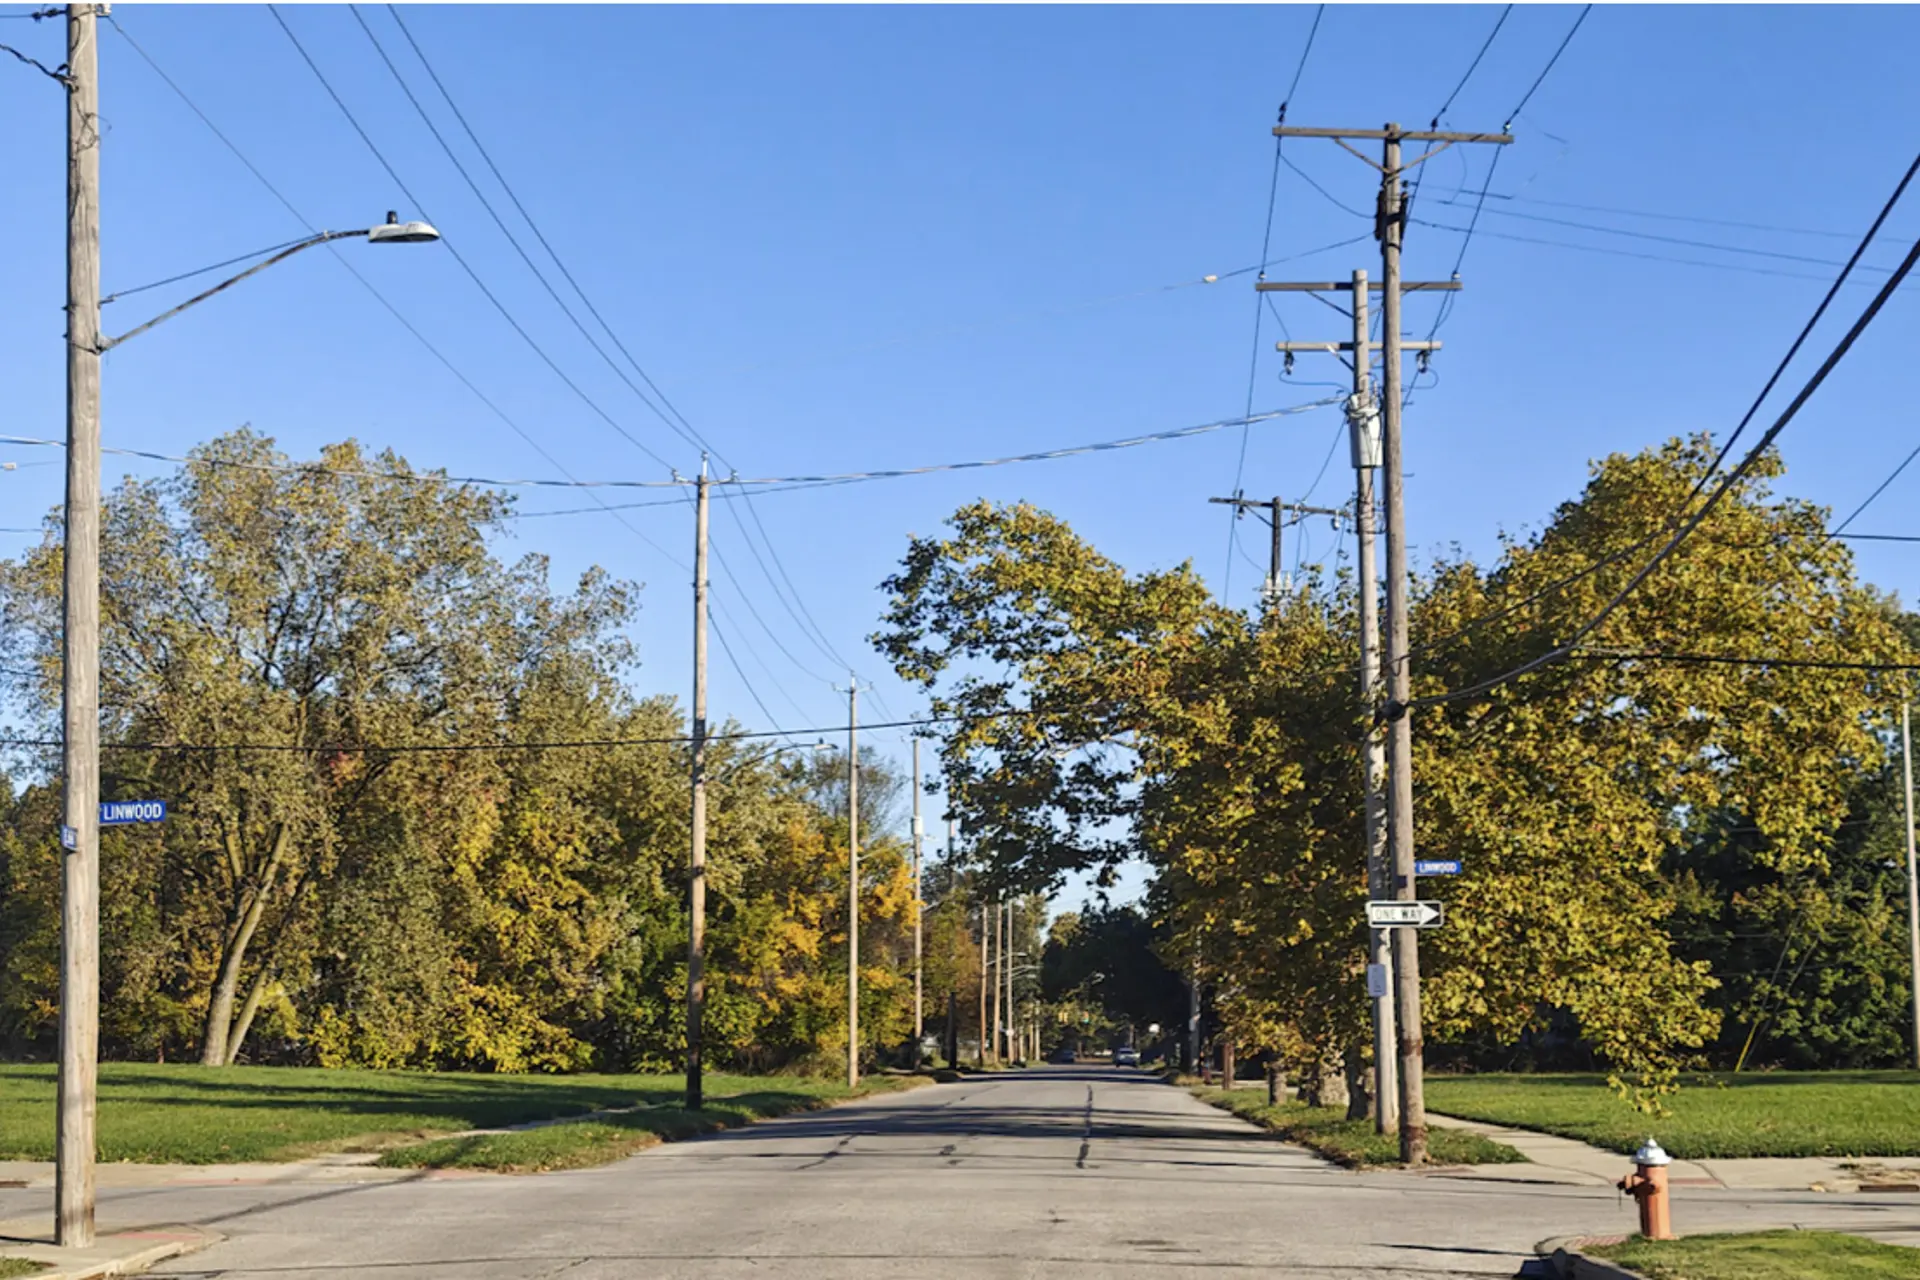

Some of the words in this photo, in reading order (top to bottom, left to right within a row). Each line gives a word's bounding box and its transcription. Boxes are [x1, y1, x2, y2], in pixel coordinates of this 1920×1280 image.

[103, 803, 162, 820] LINWOOD
[1375, 908, 1397, 920] ONE
[1401, 908, 1424, 920] WAY
